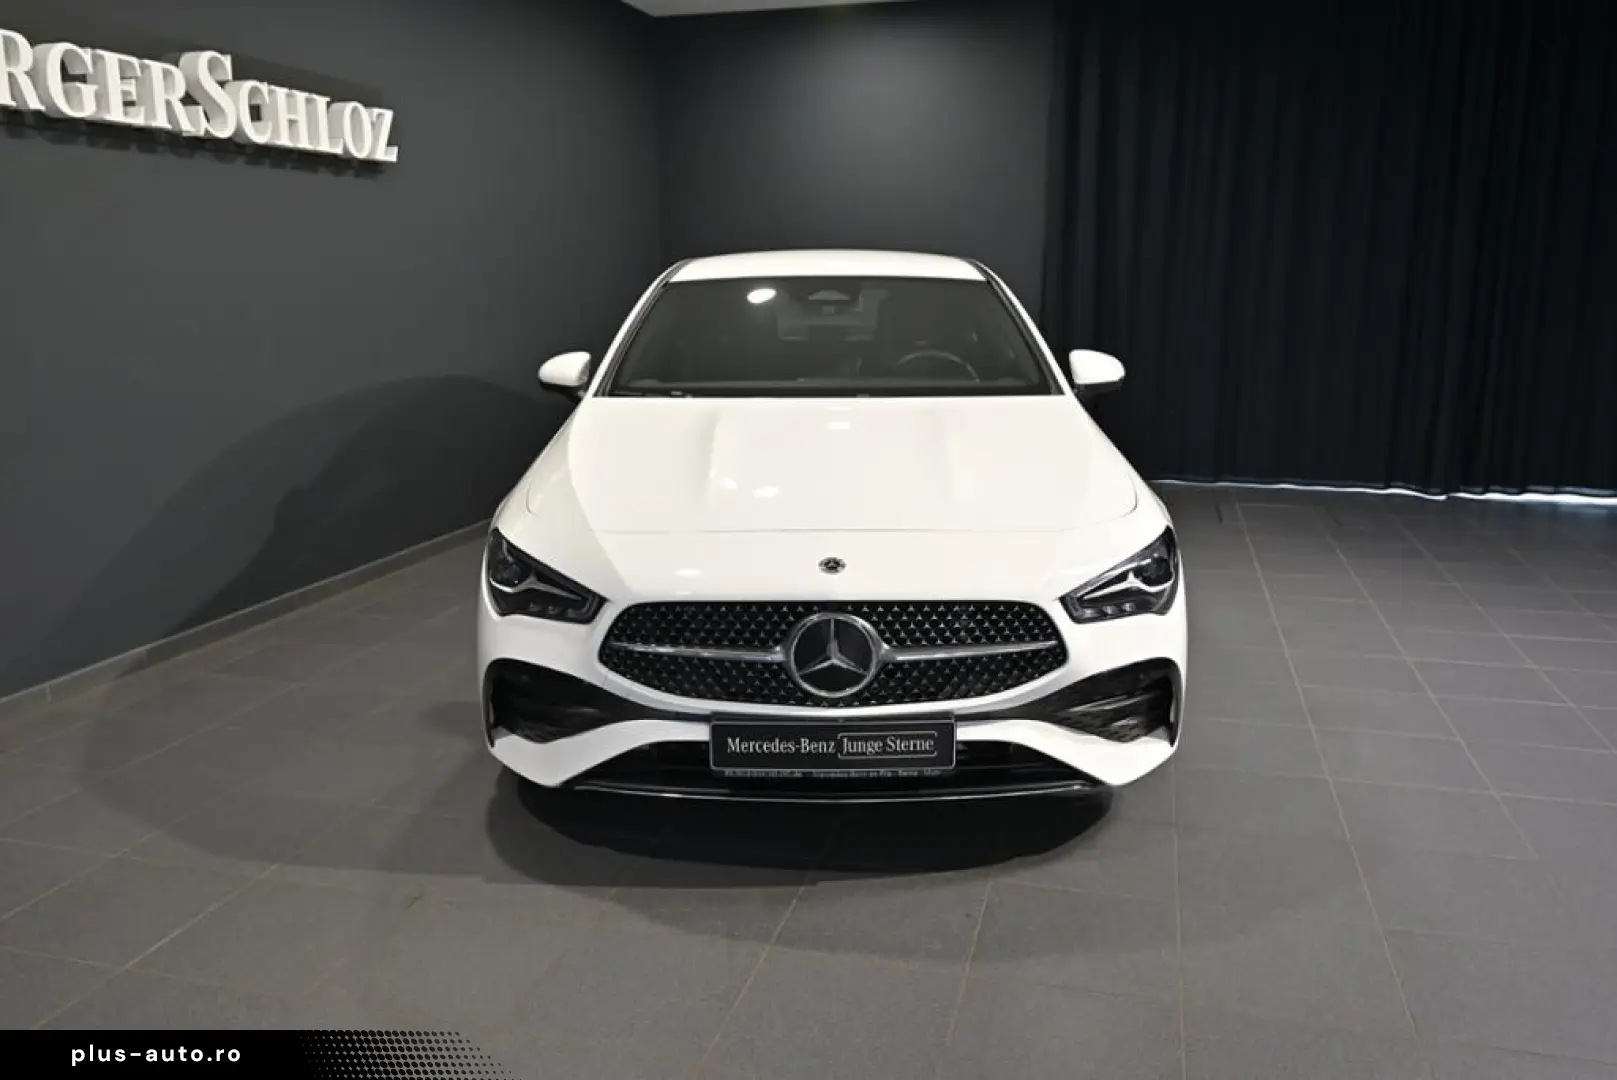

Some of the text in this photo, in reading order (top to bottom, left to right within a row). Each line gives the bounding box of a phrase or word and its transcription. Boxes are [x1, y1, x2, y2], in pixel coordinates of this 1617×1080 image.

[727, 735, 934, 756] Mercedes-Benz Junge Sterne
